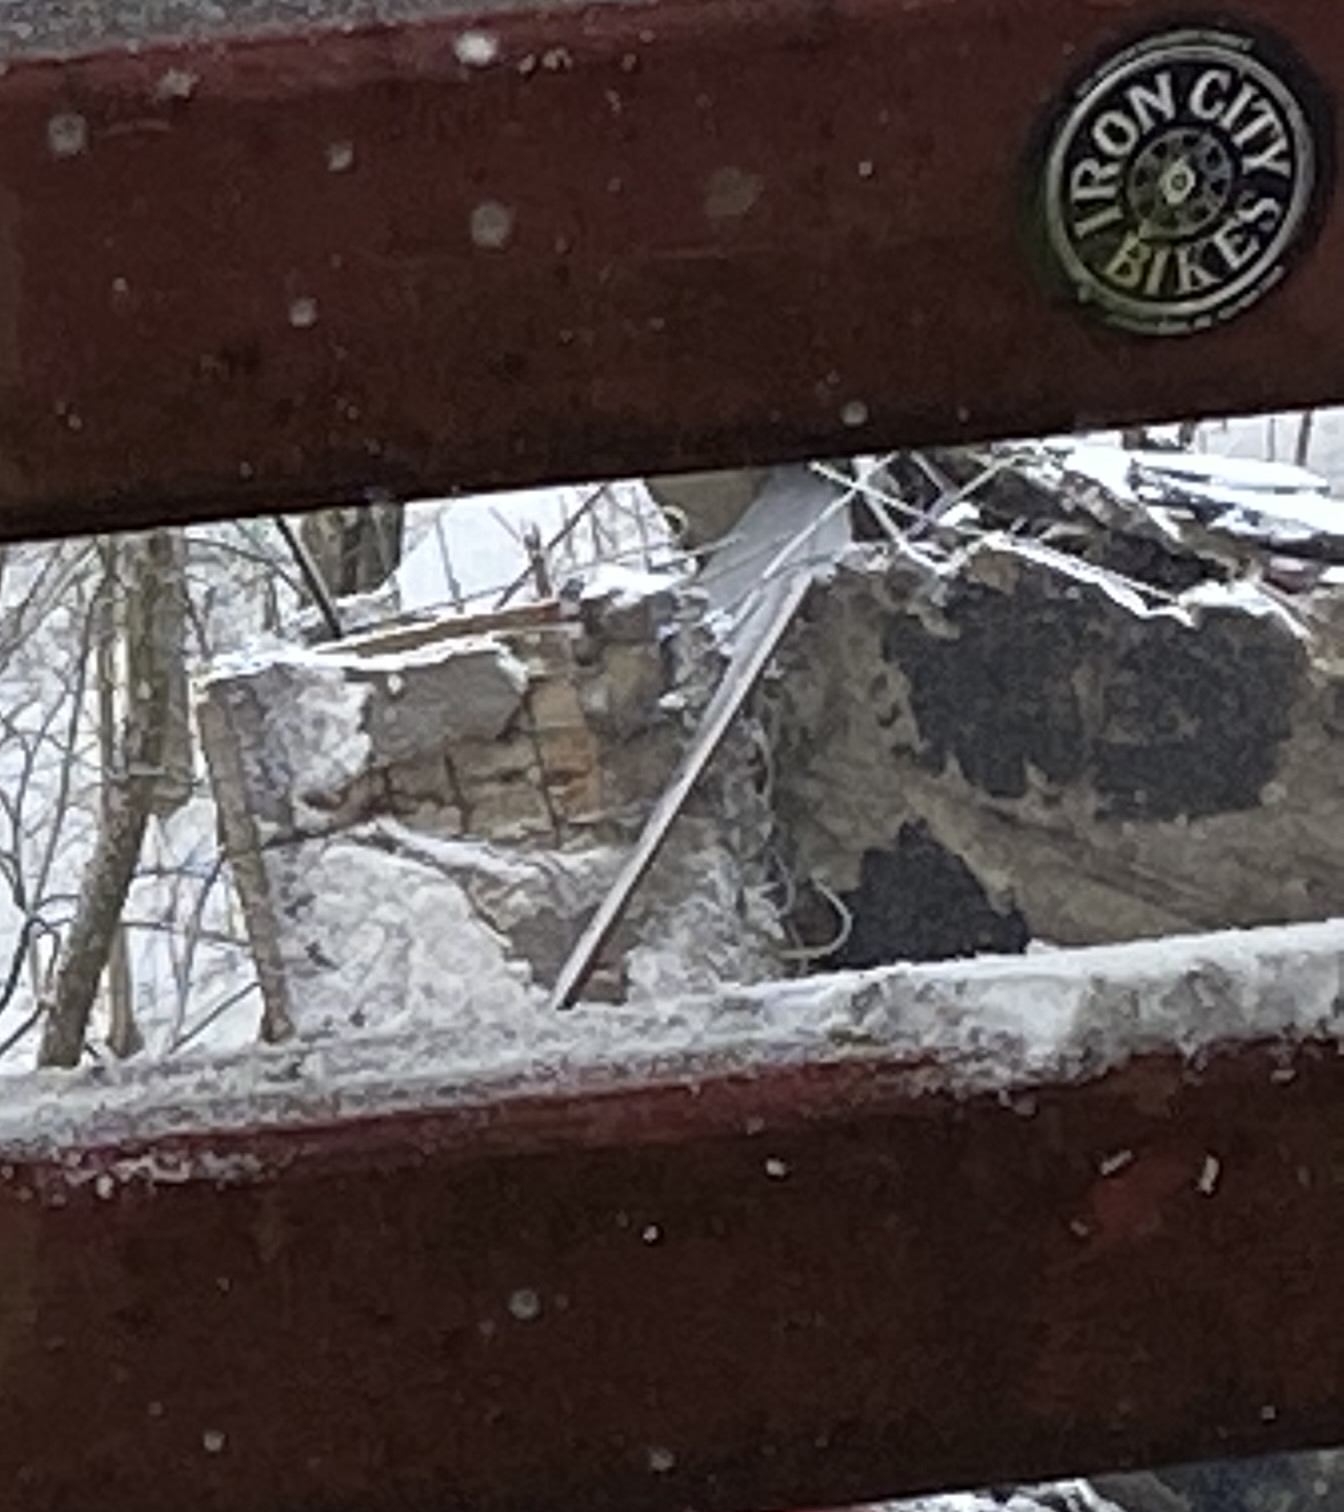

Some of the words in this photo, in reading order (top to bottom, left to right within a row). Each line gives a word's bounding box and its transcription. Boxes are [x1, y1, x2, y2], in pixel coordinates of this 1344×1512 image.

[1070, 72, 1175, 238] IRON
[1189, 69, 1291, 179] CITY
[1105, 190, 1281, 295] BIKES
